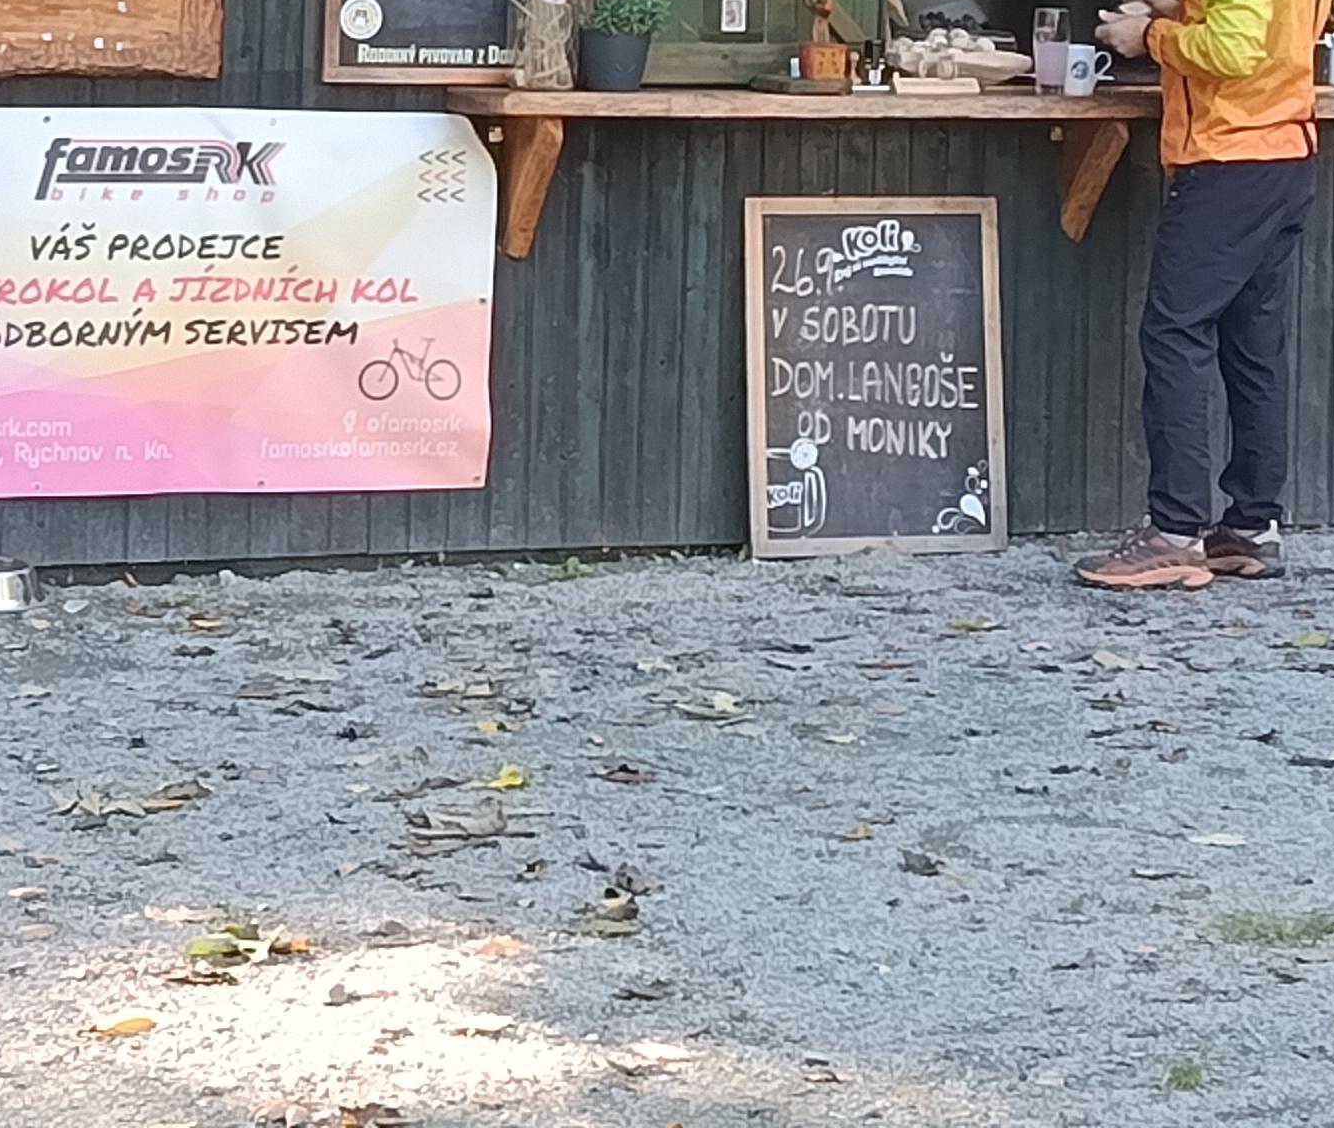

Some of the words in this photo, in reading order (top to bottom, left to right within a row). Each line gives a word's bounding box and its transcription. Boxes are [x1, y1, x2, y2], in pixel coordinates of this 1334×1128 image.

[50, 186, 144, 201] bike
[176, 187, 275, 203] shop
[30, 223, 97, 261] VÁŠ
[107, 233, 284, 261] PRODEJCE
[132, 277, 157, 303] A
[168, 265, 337, 304] JÍZDNÍCH
[351, 277, 419, 304] KOL
[184, 318, 358, 347] SERVISEM
[800, 304, 916, 345] SOBOTU
[798, 410, 831, 444] OD
[847, 415, 952, 459] MONIKY
[14, 441, 104, 469] Rychnov
